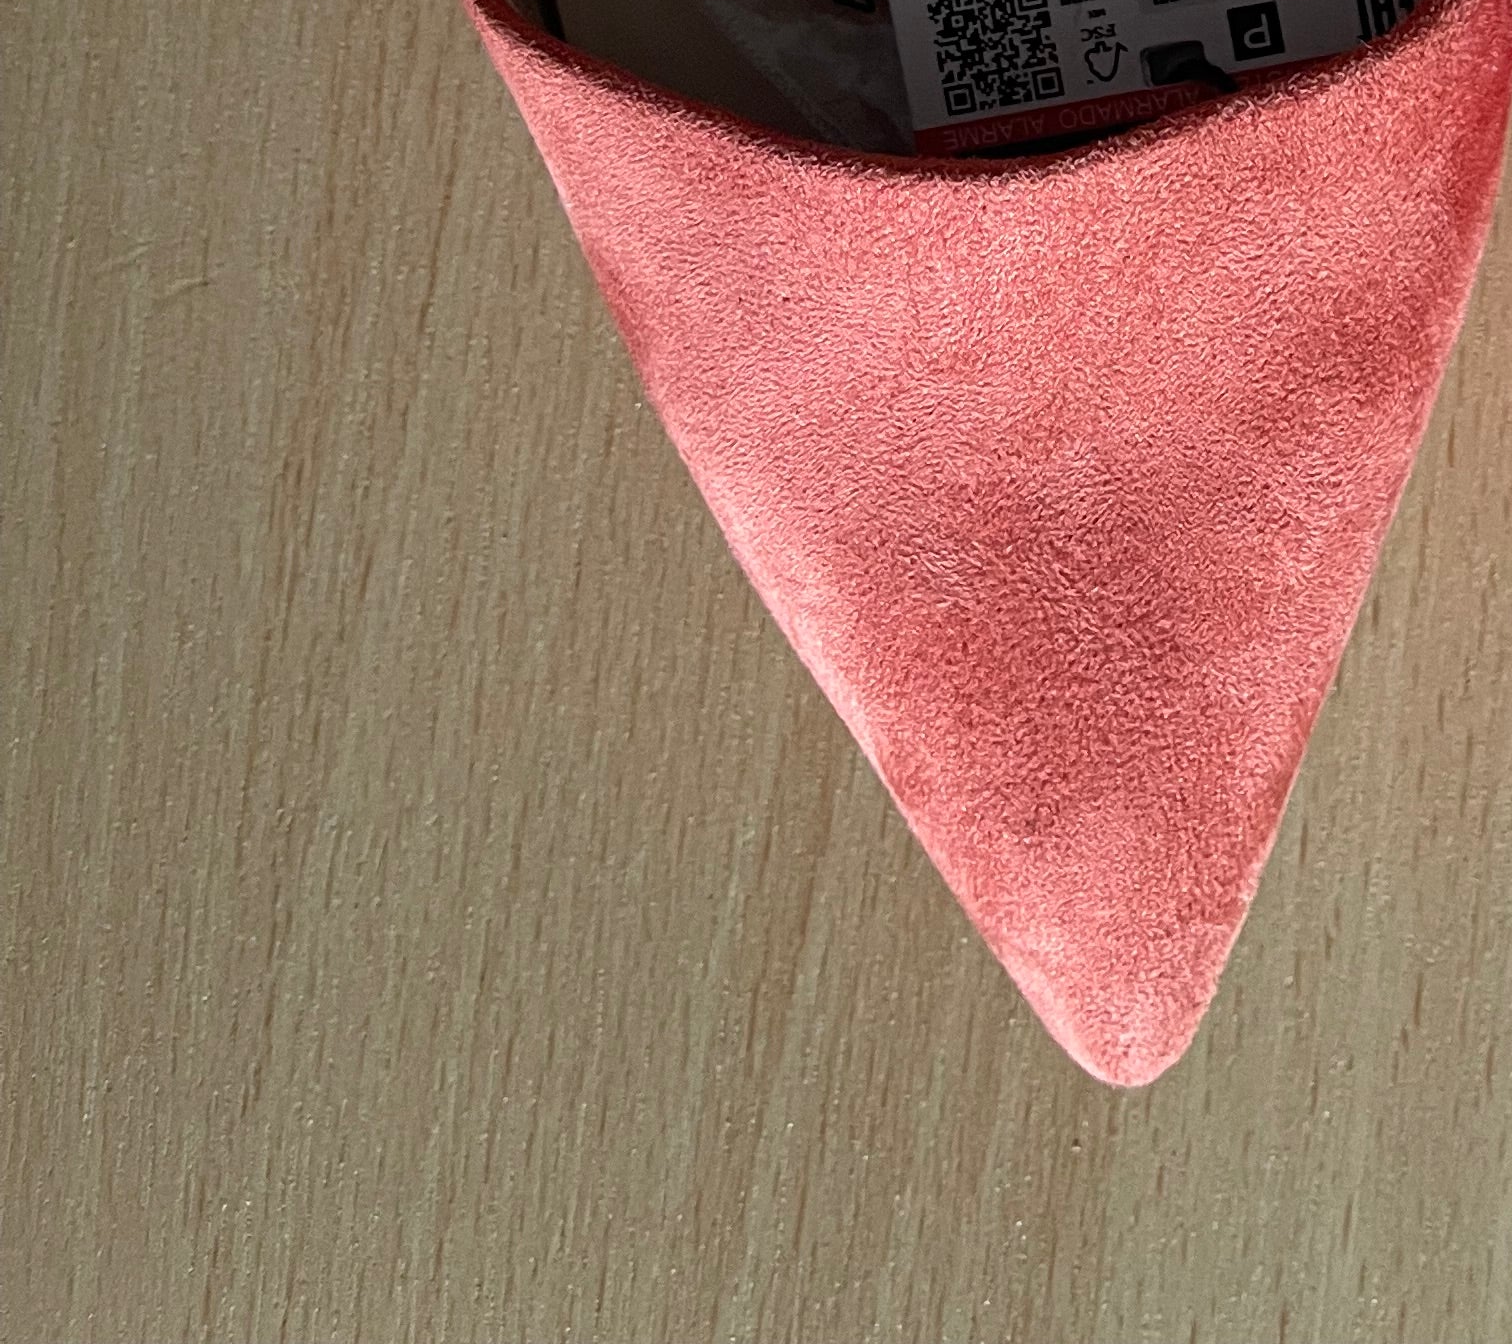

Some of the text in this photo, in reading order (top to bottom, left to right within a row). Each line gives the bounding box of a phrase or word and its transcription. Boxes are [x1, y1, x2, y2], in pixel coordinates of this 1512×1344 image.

[1080, 23, 1117, 42] FSC
[943, 84, 1198, 150] ALARMADO ALARME
